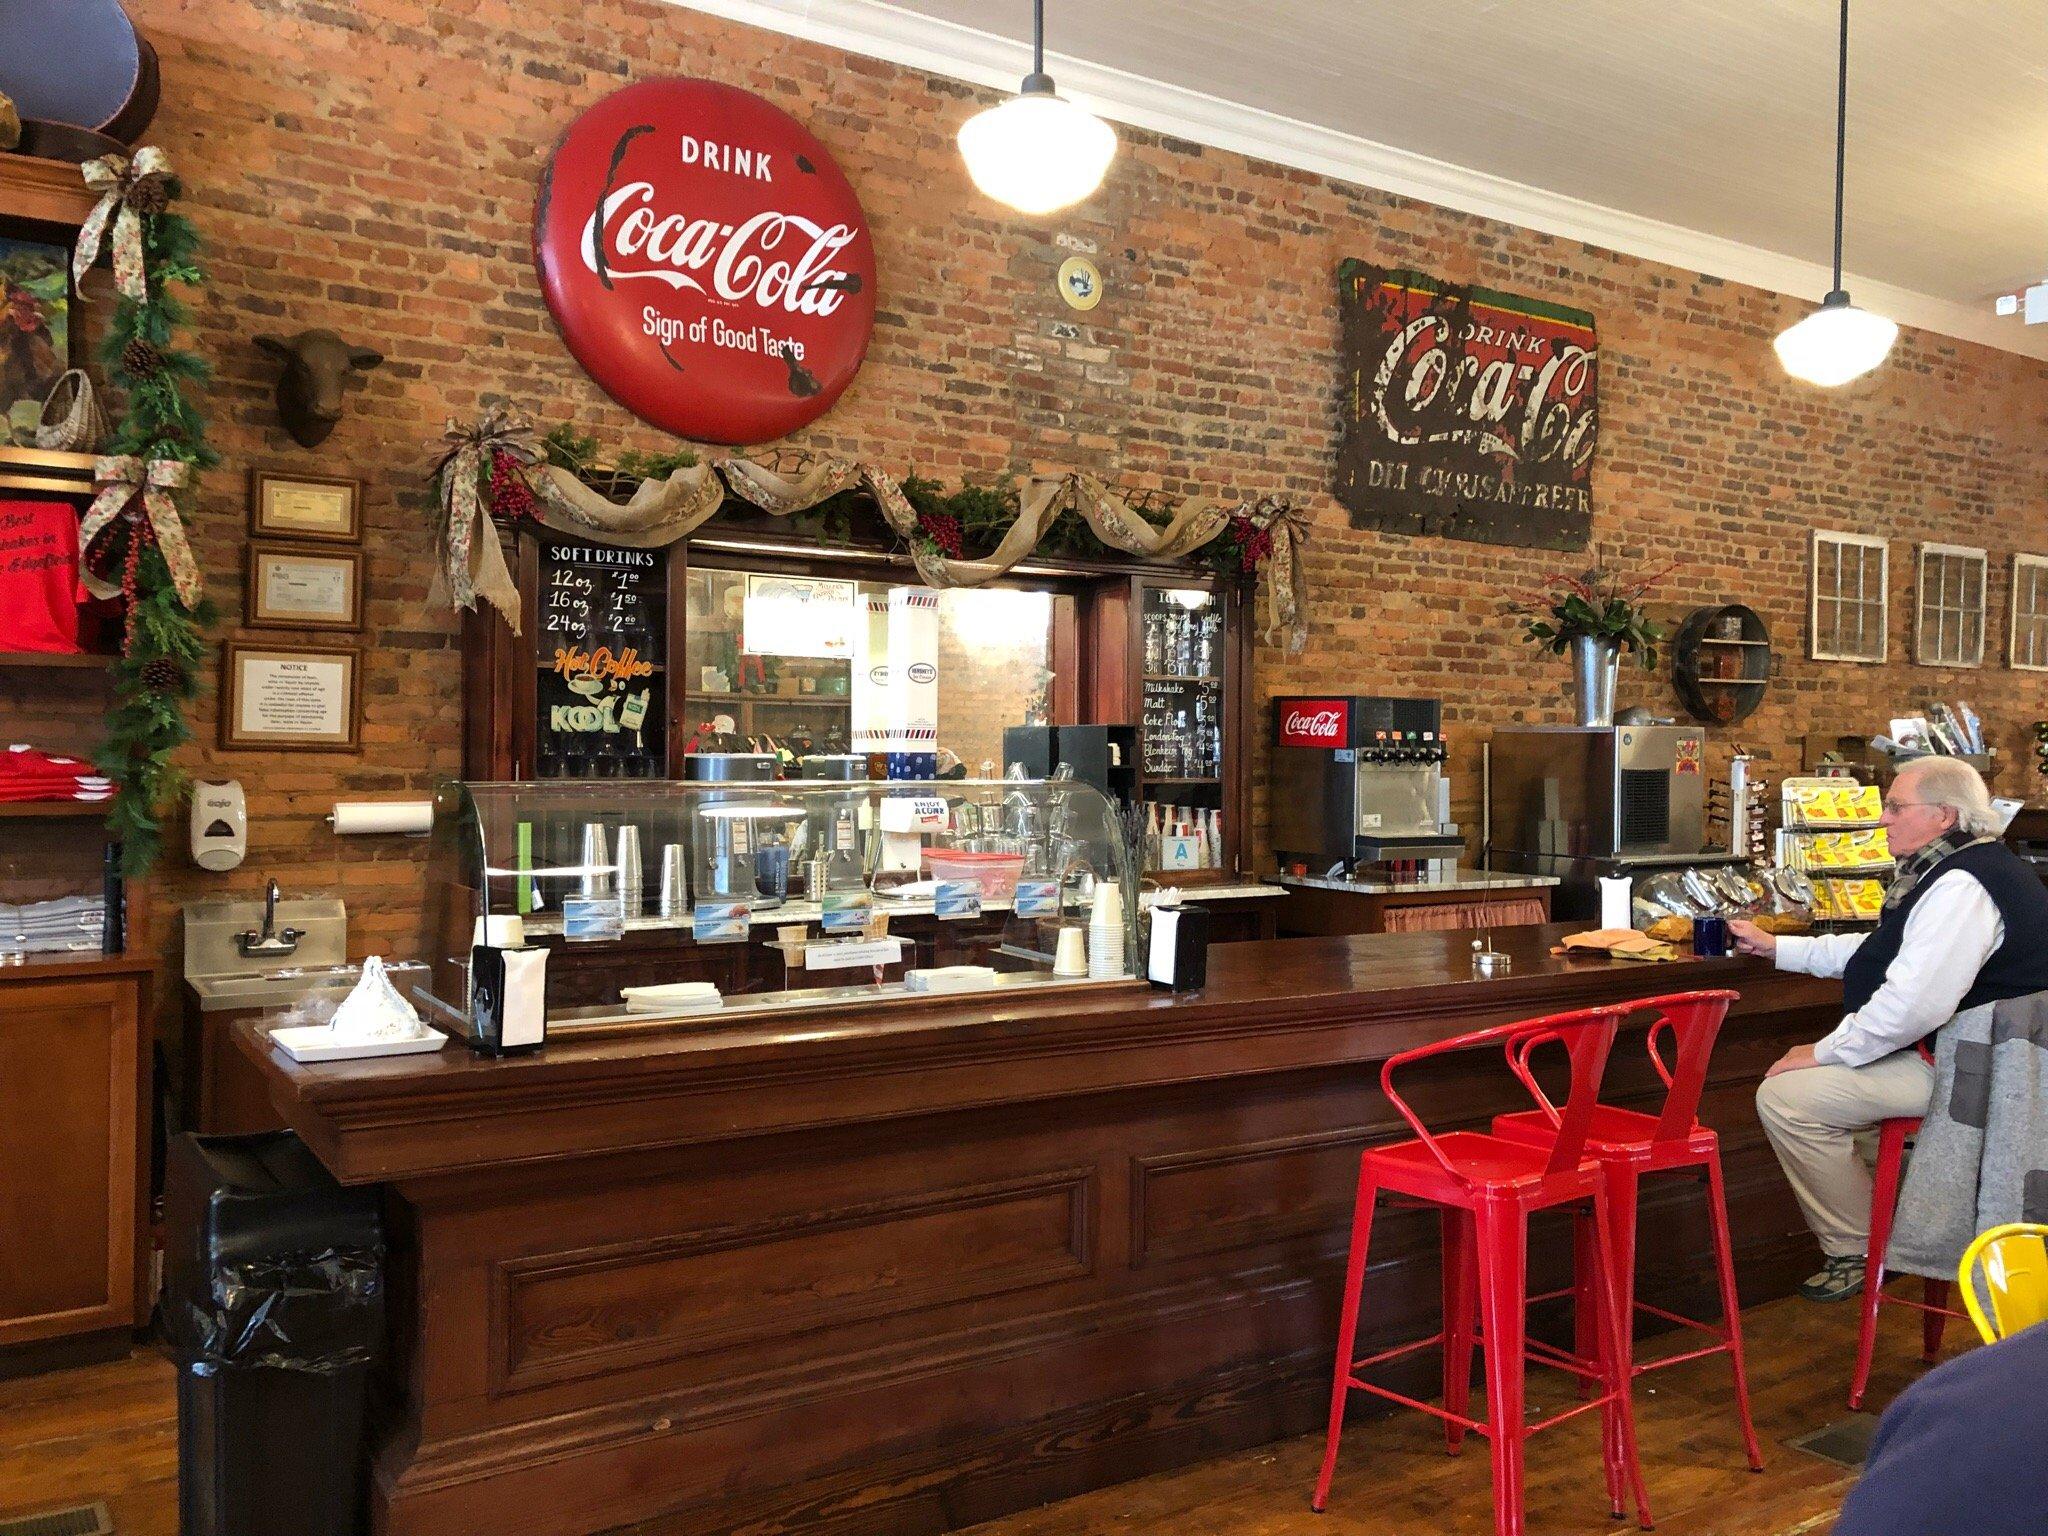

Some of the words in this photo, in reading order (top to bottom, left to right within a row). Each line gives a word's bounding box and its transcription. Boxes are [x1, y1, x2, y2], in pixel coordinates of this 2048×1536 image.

[682, 135, 772, 182] DRINK
[581, 181, 858, 317] Coca-Cola
[643, 306, 684, 346] Sign
[689, 316, 707, 343] of
[713, 318, 757, 352] Good
[759, 328, 805, 361] Taste
[1459, 323, 1546, 354] DRINK
[551, 546, 592, 562] SOFT
[595, 549, 654, 567] DRINKS
[551, 569, 574, 587] 12
[549, 590, 570, 607] 16
[547, 614, 570, 632] 24
[280, 664, 308, 672] NOTICE
[553, 645, 590, 682] Hot
[589, 646, 653, 682] Coffee
[1144, 682, 1185, 693] Milkshake
[1143, 697, 1166, 709] Malt
[550, 704, 621, 734] KOOL
[1143, 713, 1164, 726] Coke
[1285, 710, 1342, 737] Coca-Cola
[1174, 842, 1189, 860] A
